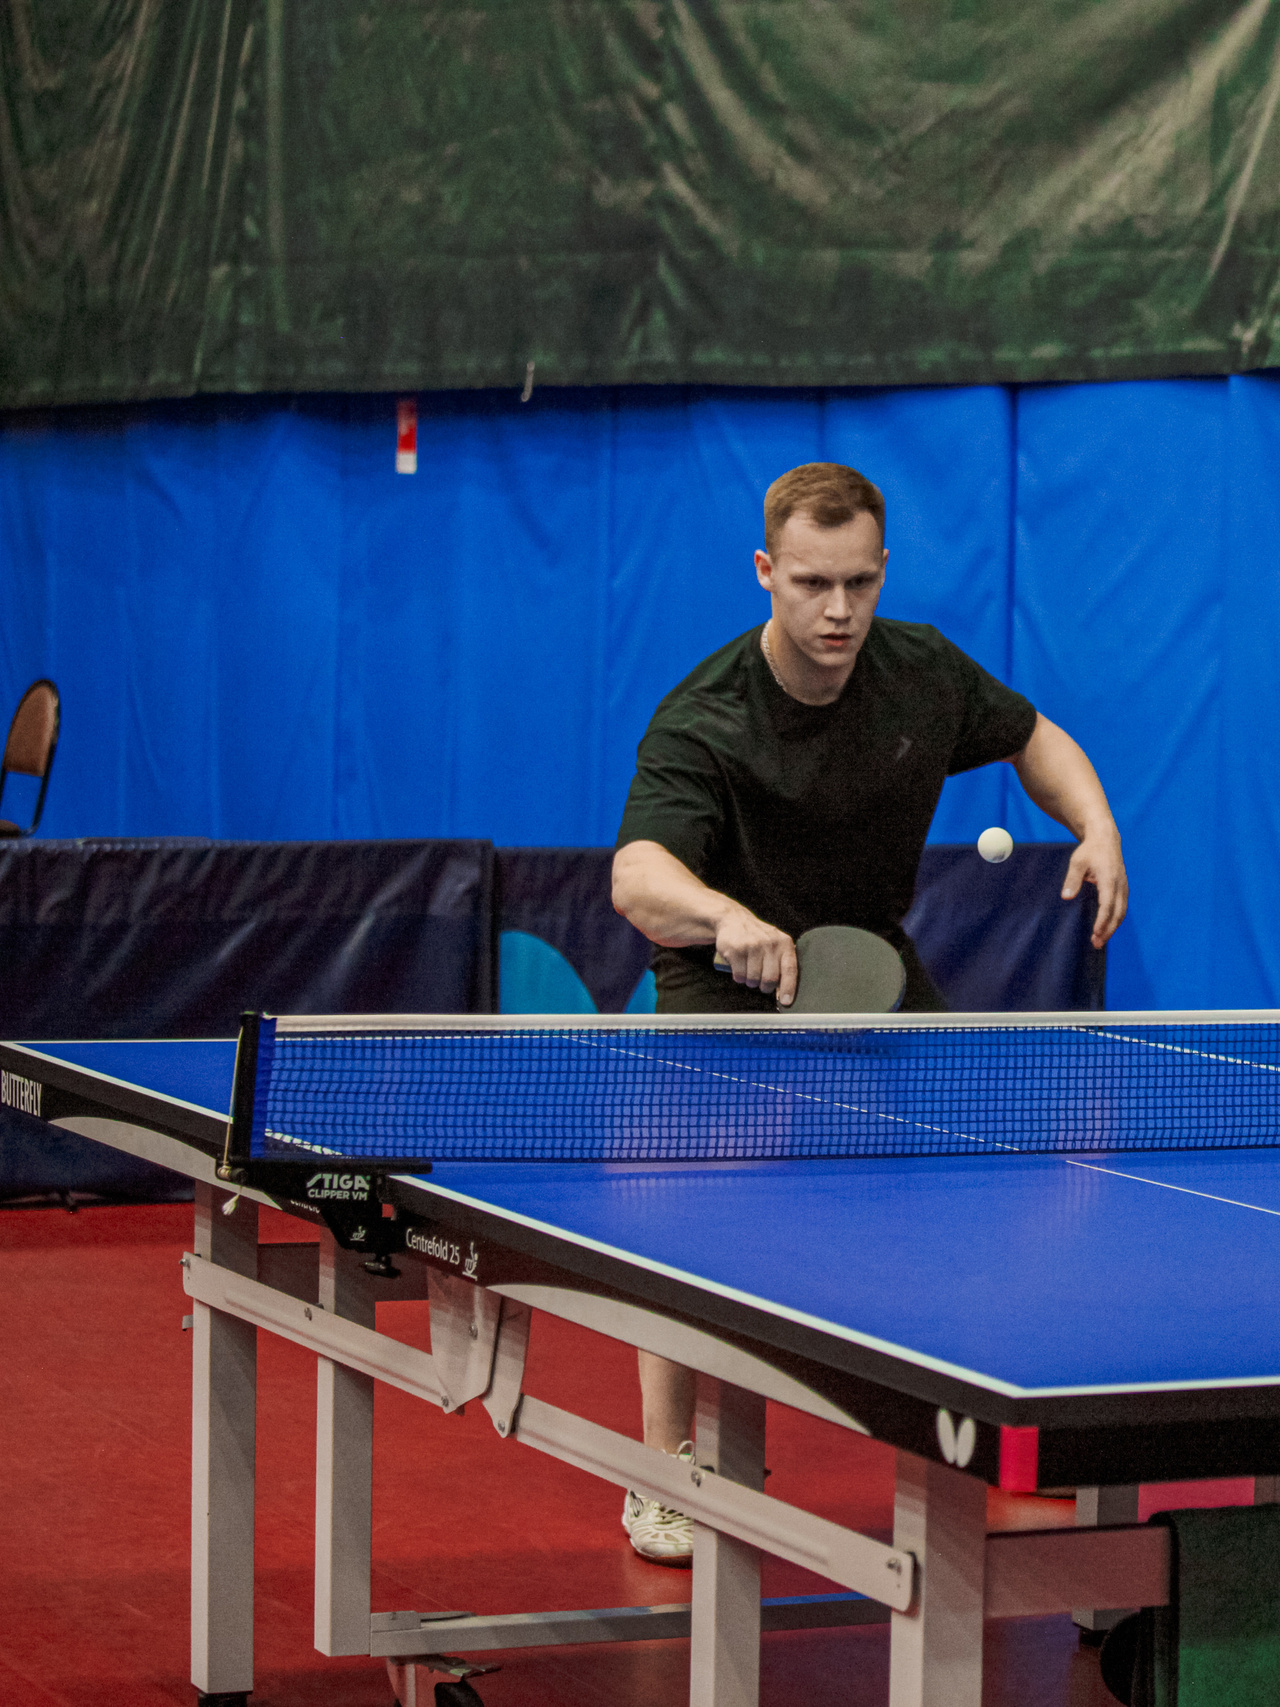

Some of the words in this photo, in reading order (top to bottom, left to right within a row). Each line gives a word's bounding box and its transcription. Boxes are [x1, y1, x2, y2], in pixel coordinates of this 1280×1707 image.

[1, 1069, 42, 1117] BUTTERFLY
[306, 1173, 370, 1191] STIGA
[308, 1188, 350, 1200] CLIPPER
[352, 1190, 368, 1201] VM
[406, 1227, 448, 1261] Centrefold
[449, 1244, 460, 1265] 25
